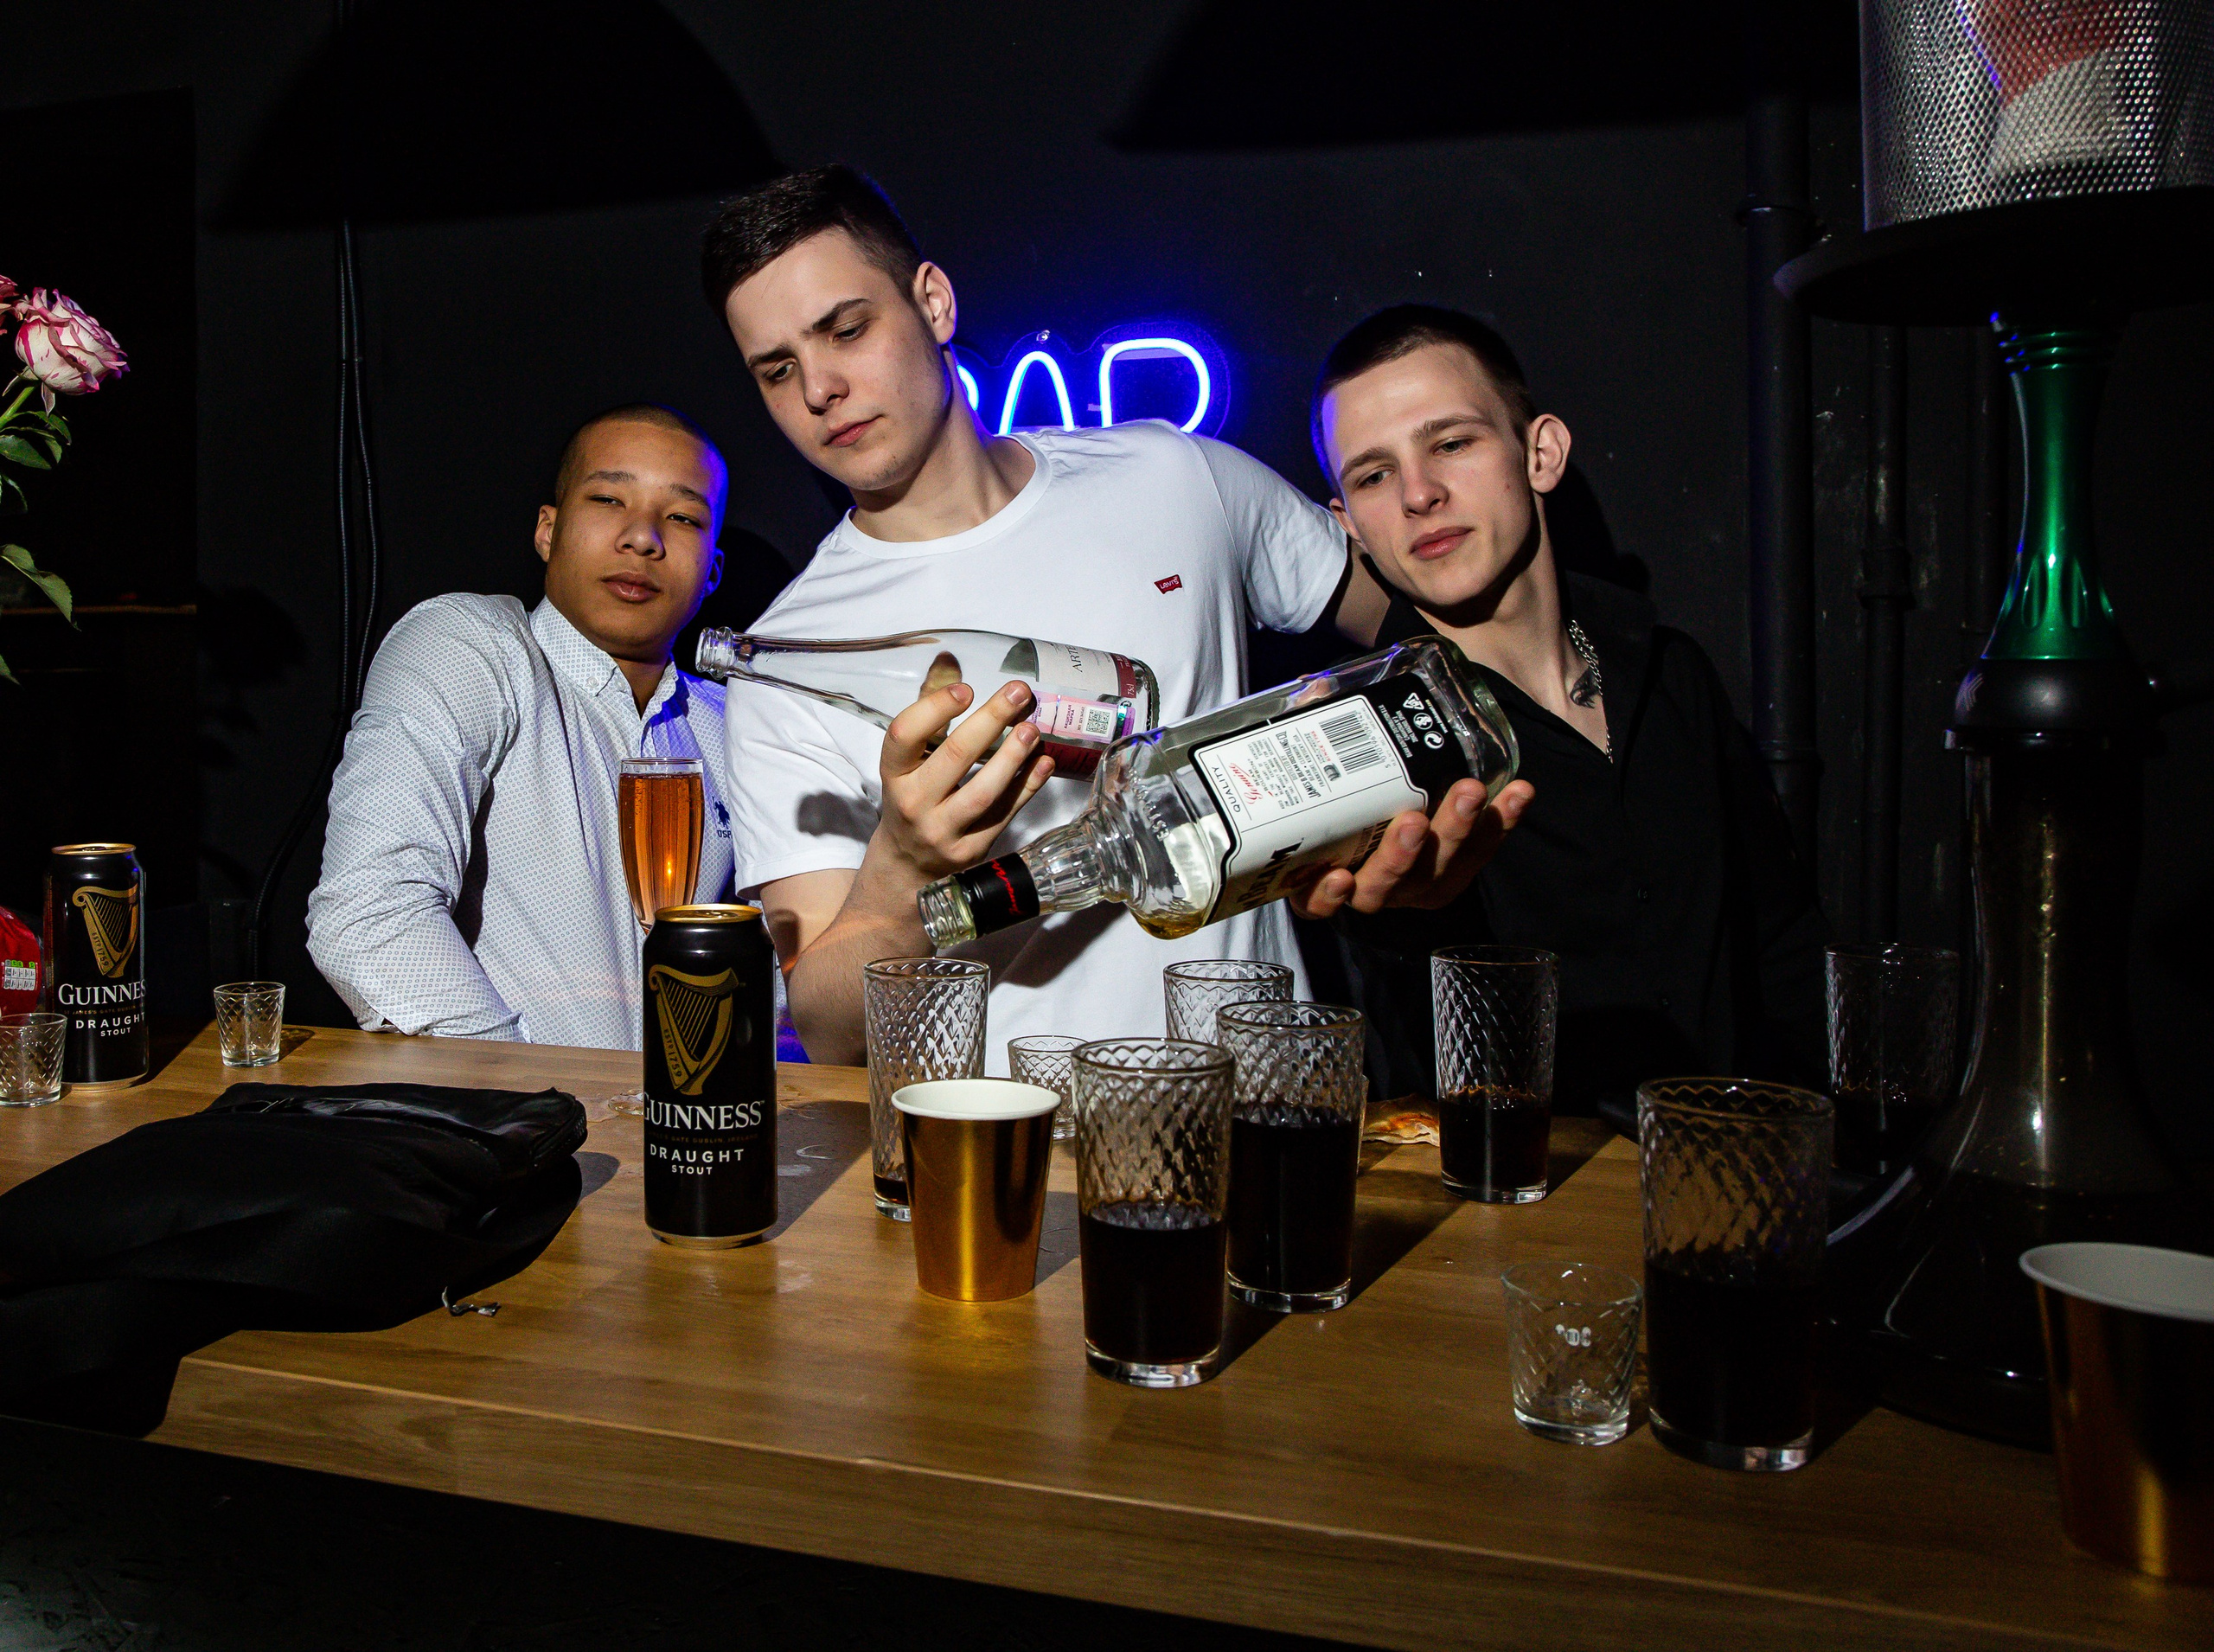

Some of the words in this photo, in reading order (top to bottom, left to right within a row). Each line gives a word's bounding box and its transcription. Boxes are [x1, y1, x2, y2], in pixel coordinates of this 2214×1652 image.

[957, 337, 1211, 435] AR
[1279, 739, 1298, 764] DISTILLING
[1298, 743, 1311, 762] KENTUCKY
[1248, 769, 1259, 785] BEAM
[1283, 760, 1297, 779] DISTILLED
[1293, 764, 1303, 777] BEAM
[1309, 763, 1324, 786] FRANKFORT
[1212, 765, 1241, 813] QUALITY
[1229, 762, 1264, 805] Genuine
[1302, 779, 1321, 799] JAMES
[75, 1011, 145, 1030] DRAUGHT
[100, 1027, 131, 1038] STOUT
[668, 1051, 681, 1077] 1759
[649, 1143, 745, 1163] DRAUGHT
[671, 1164, 713, 1175] STOUT
